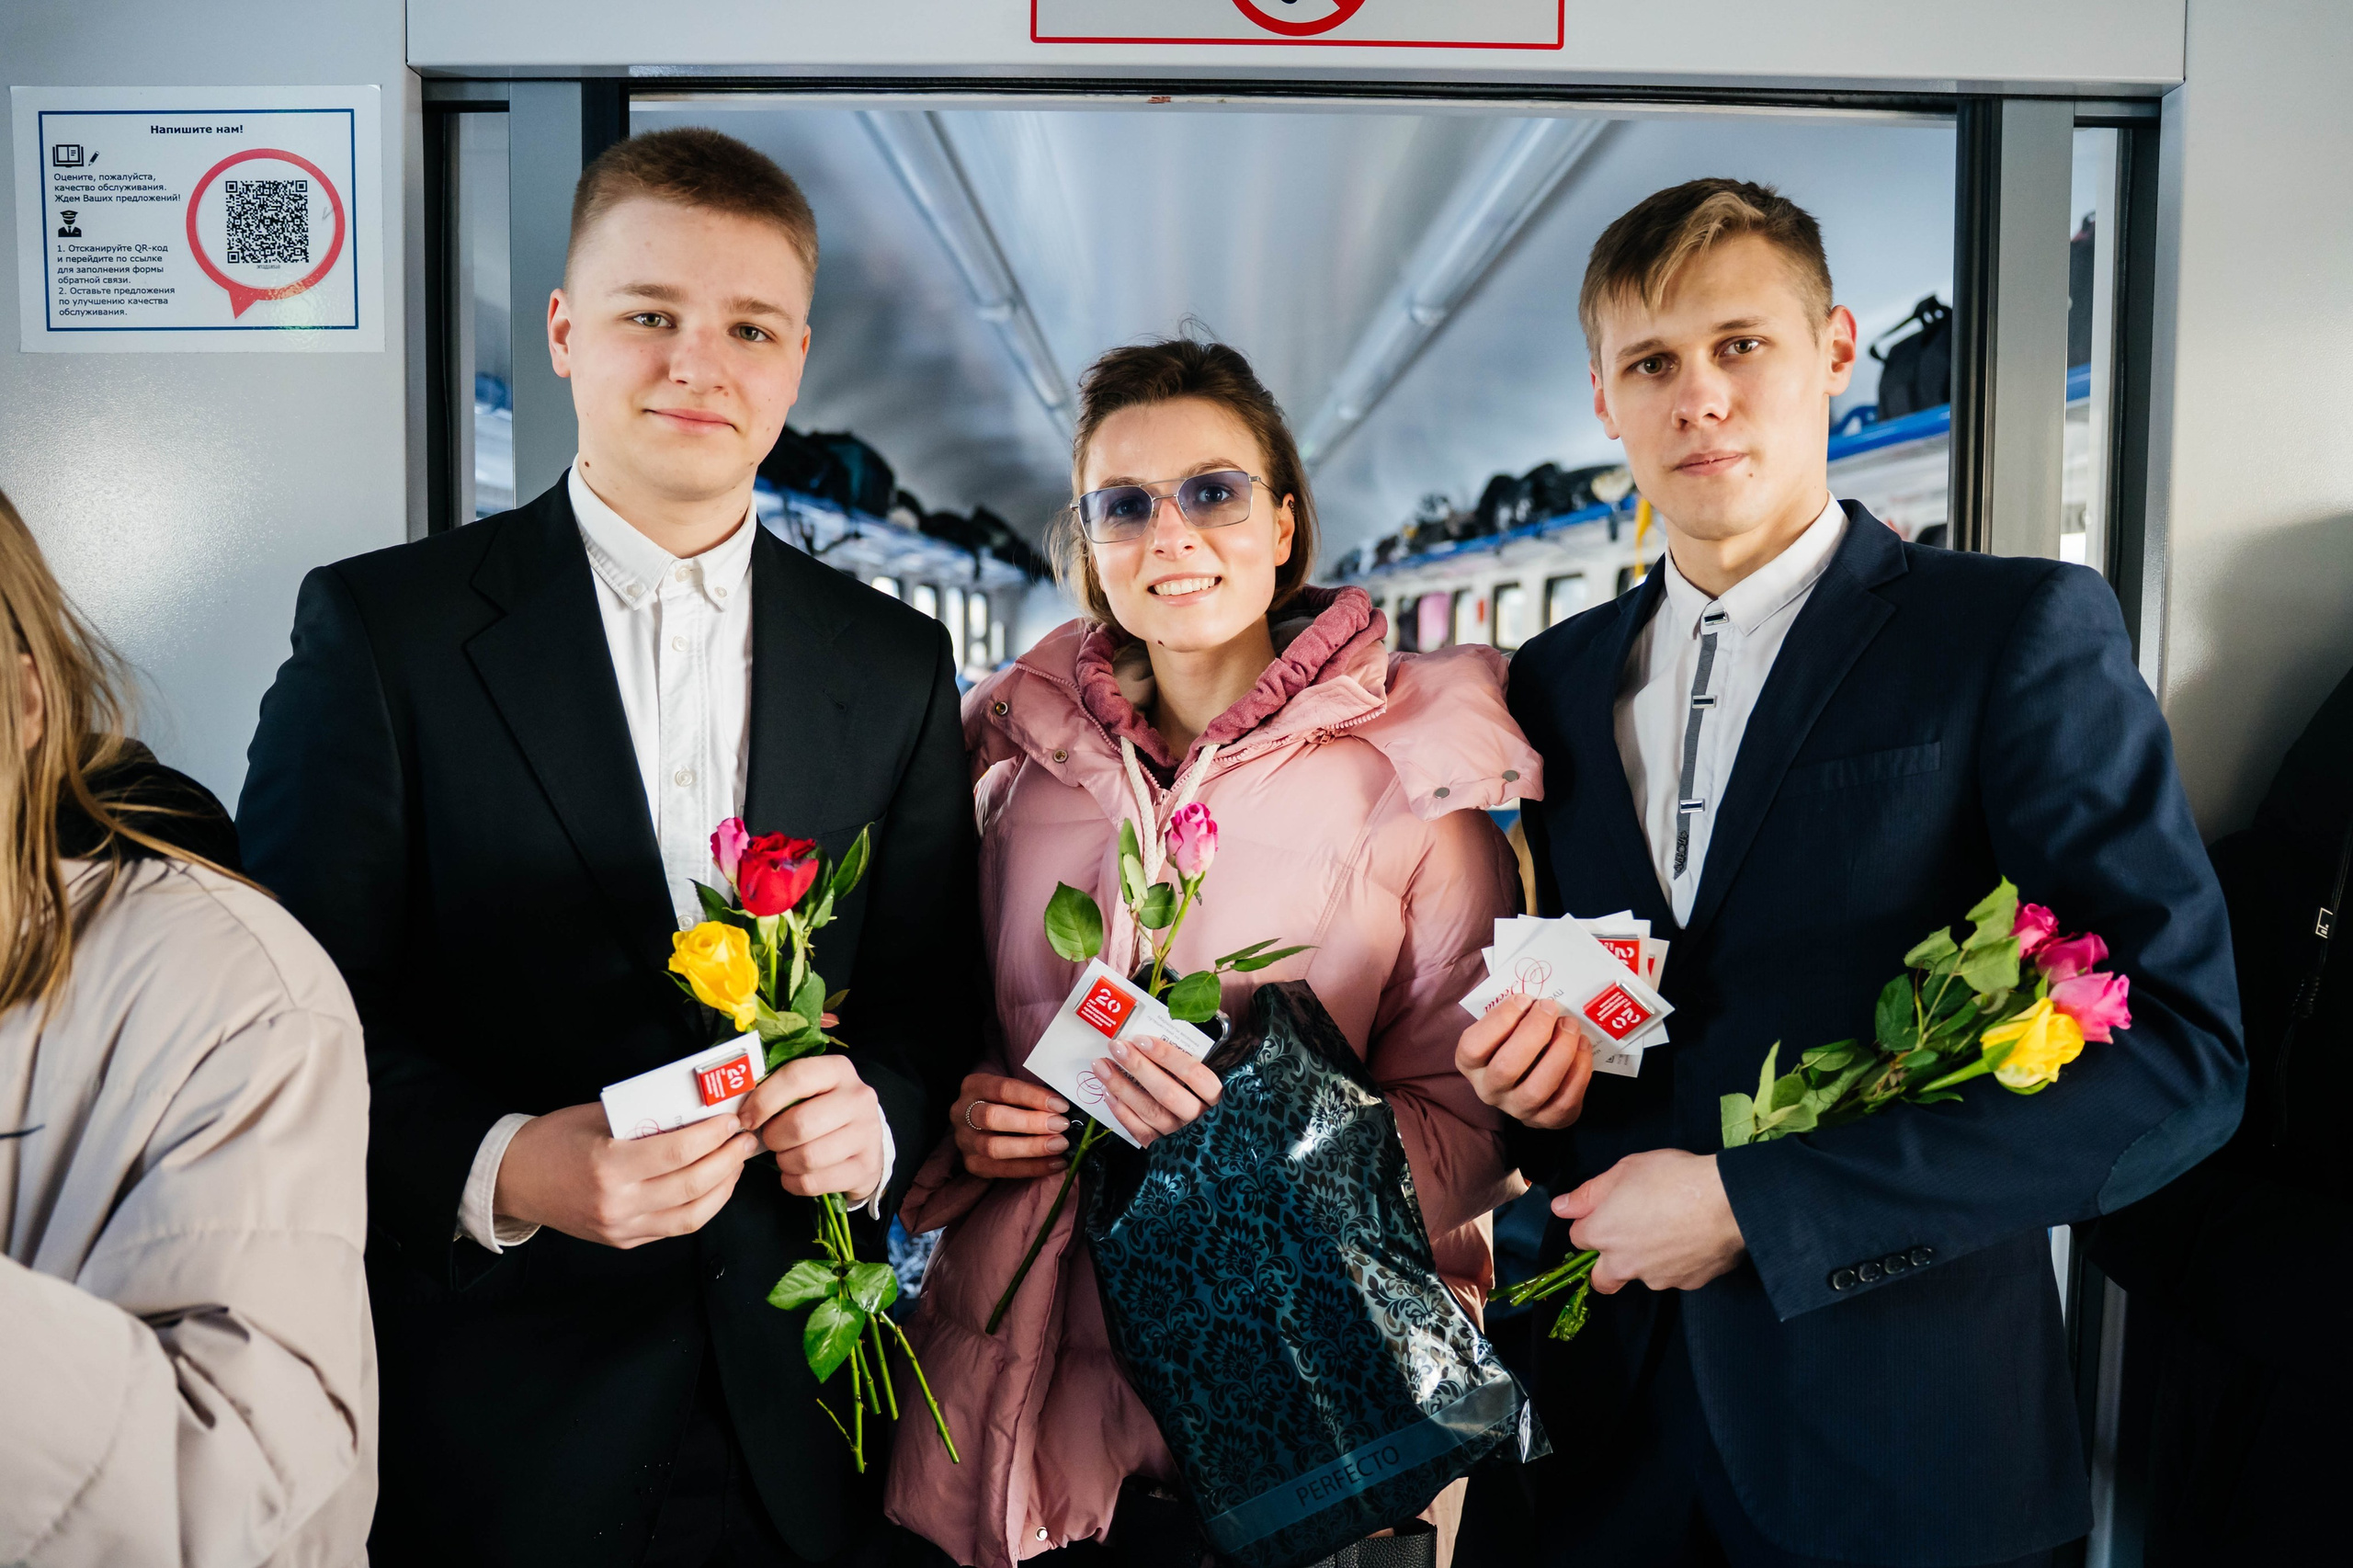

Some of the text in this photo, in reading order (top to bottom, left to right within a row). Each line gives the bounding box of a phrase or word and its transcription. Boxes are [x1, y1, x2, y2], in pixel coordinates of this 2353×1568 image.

[150, 124, 244, 135] Напишите нам!
[53, 172, 156, 183] Оцените, пожалуйста,
[97, 182, 167, 193] обслуживания.
[53, 193, 181, 204] Ждем Ваших предложений!
[57, 244, 169, 255] 1. Отсканируйте QR-код
[64, 254, 115, 265] перейдите
[56, 267, 74, 275] для
[131, 265, 165, 275] формы
[57, 275, 101, 286] обратной
[58, 286, 176, 296] 2. Оставьте предложения
[71, 298, 126, 308] улучшению
[58, 307, 128, 318] обслуживания.
[1095, 988, 1121, 1014] 20
[1611, 1007, 1642, 1029] 20
[726, 1063, 747, 1089] 20
[1295, 1446, 1400, 1507] PERFECTO
